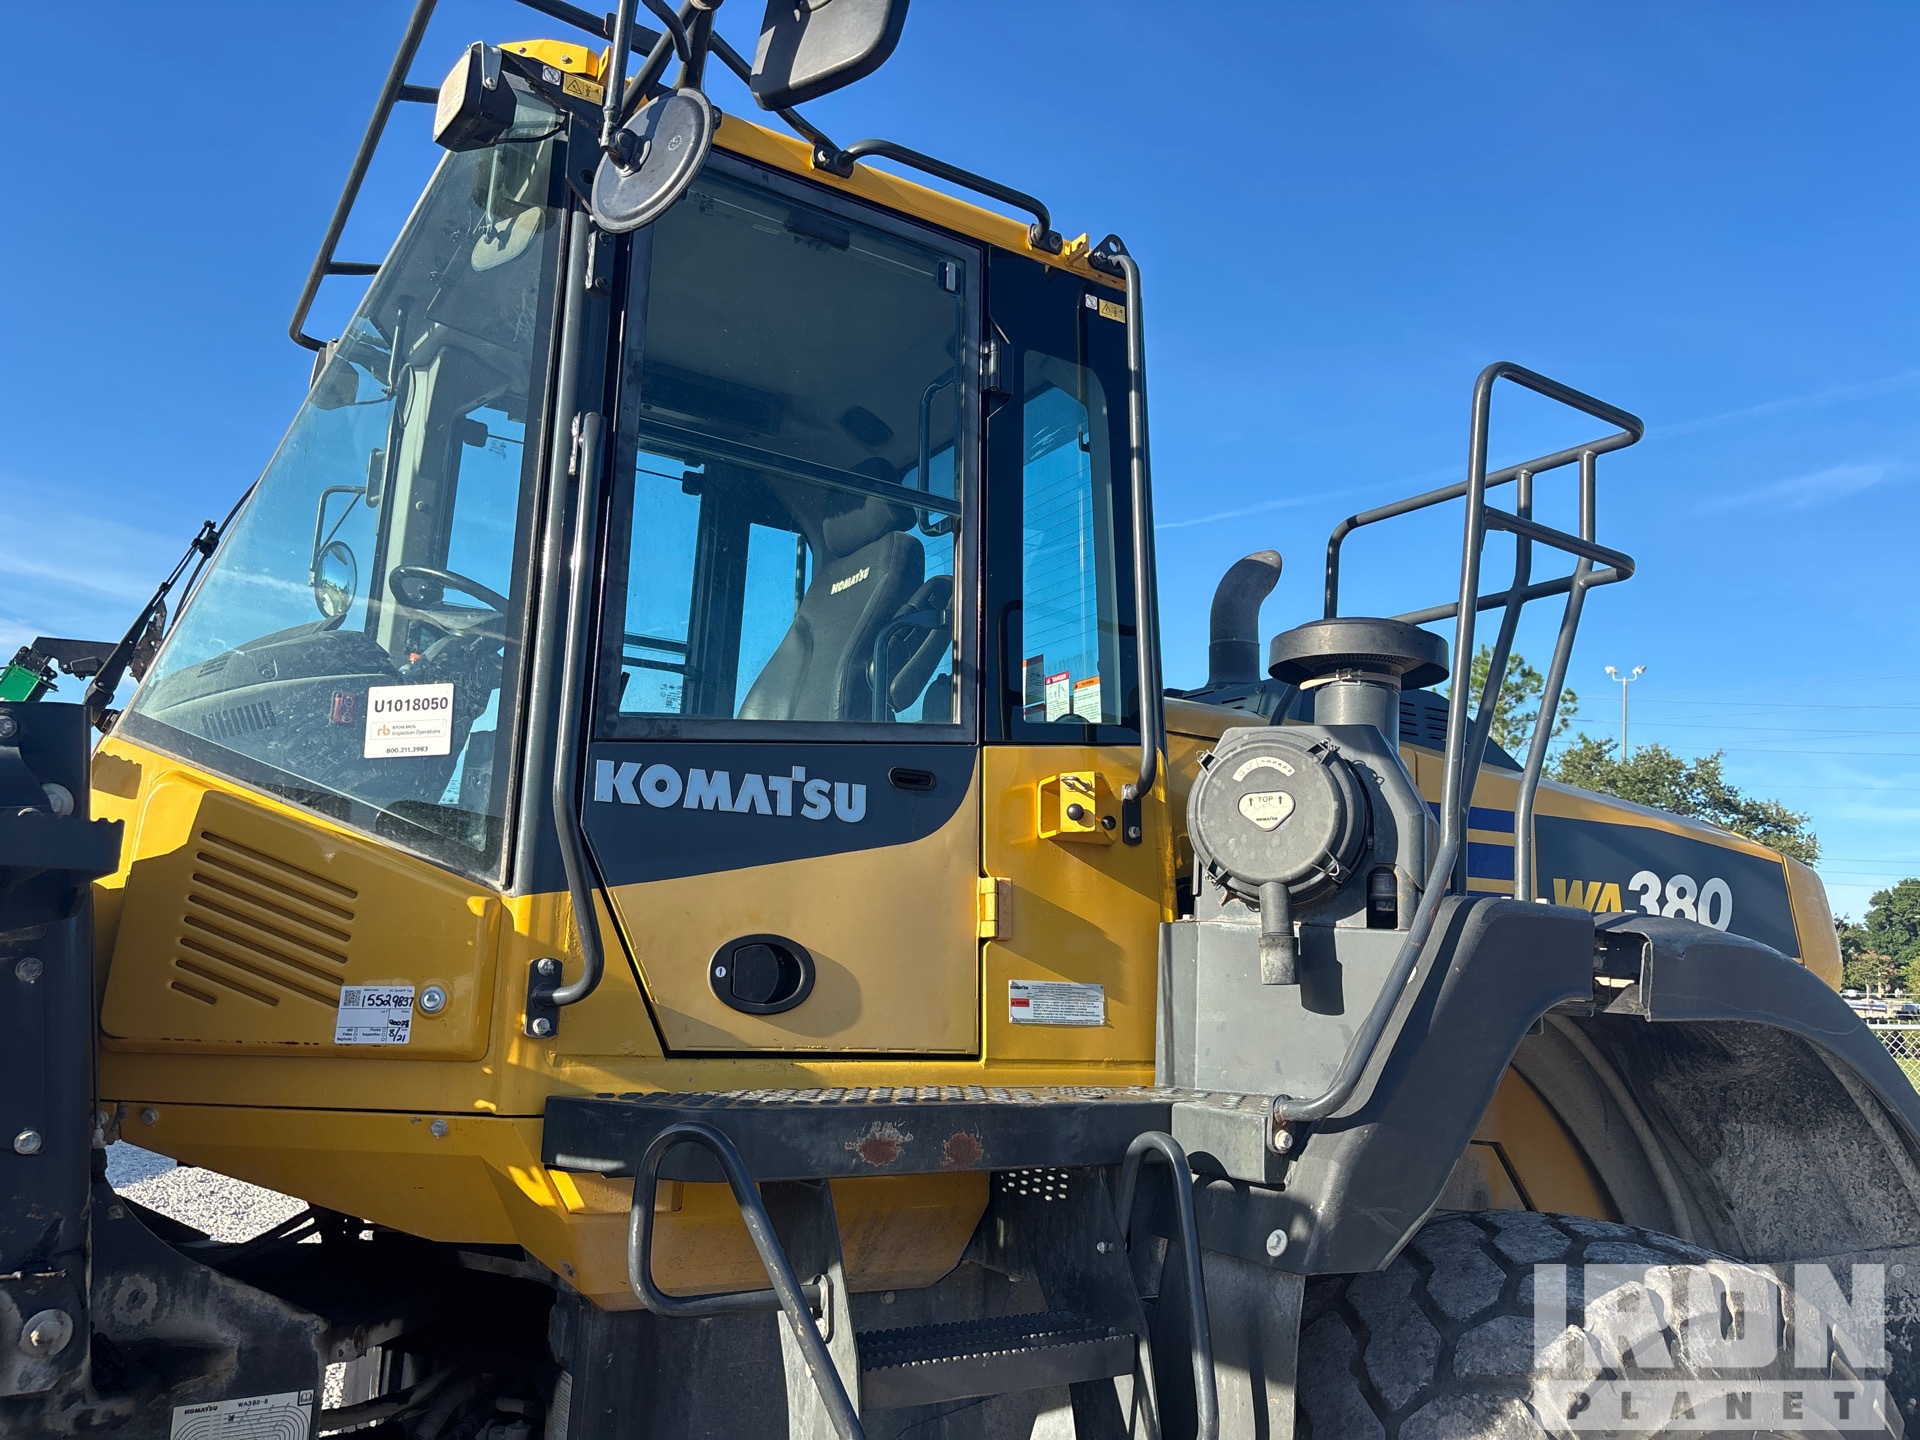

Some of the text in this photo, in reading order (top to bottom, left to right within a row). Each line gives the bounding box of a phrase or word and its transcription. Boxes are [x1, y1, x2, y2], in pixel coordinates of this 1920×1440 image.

[830, 566, 870, 595] KOMATSU
[374, 697, 449, 713] U1018050
[377, 724, 391, 737] rb
[594, 759, 867, 823] KOMATSU
[362, 994, 414, 1008] 15529837
[388, 1028, 406, 1042] 8/21
[184, 1405, 218, 1415] KOMATSU
